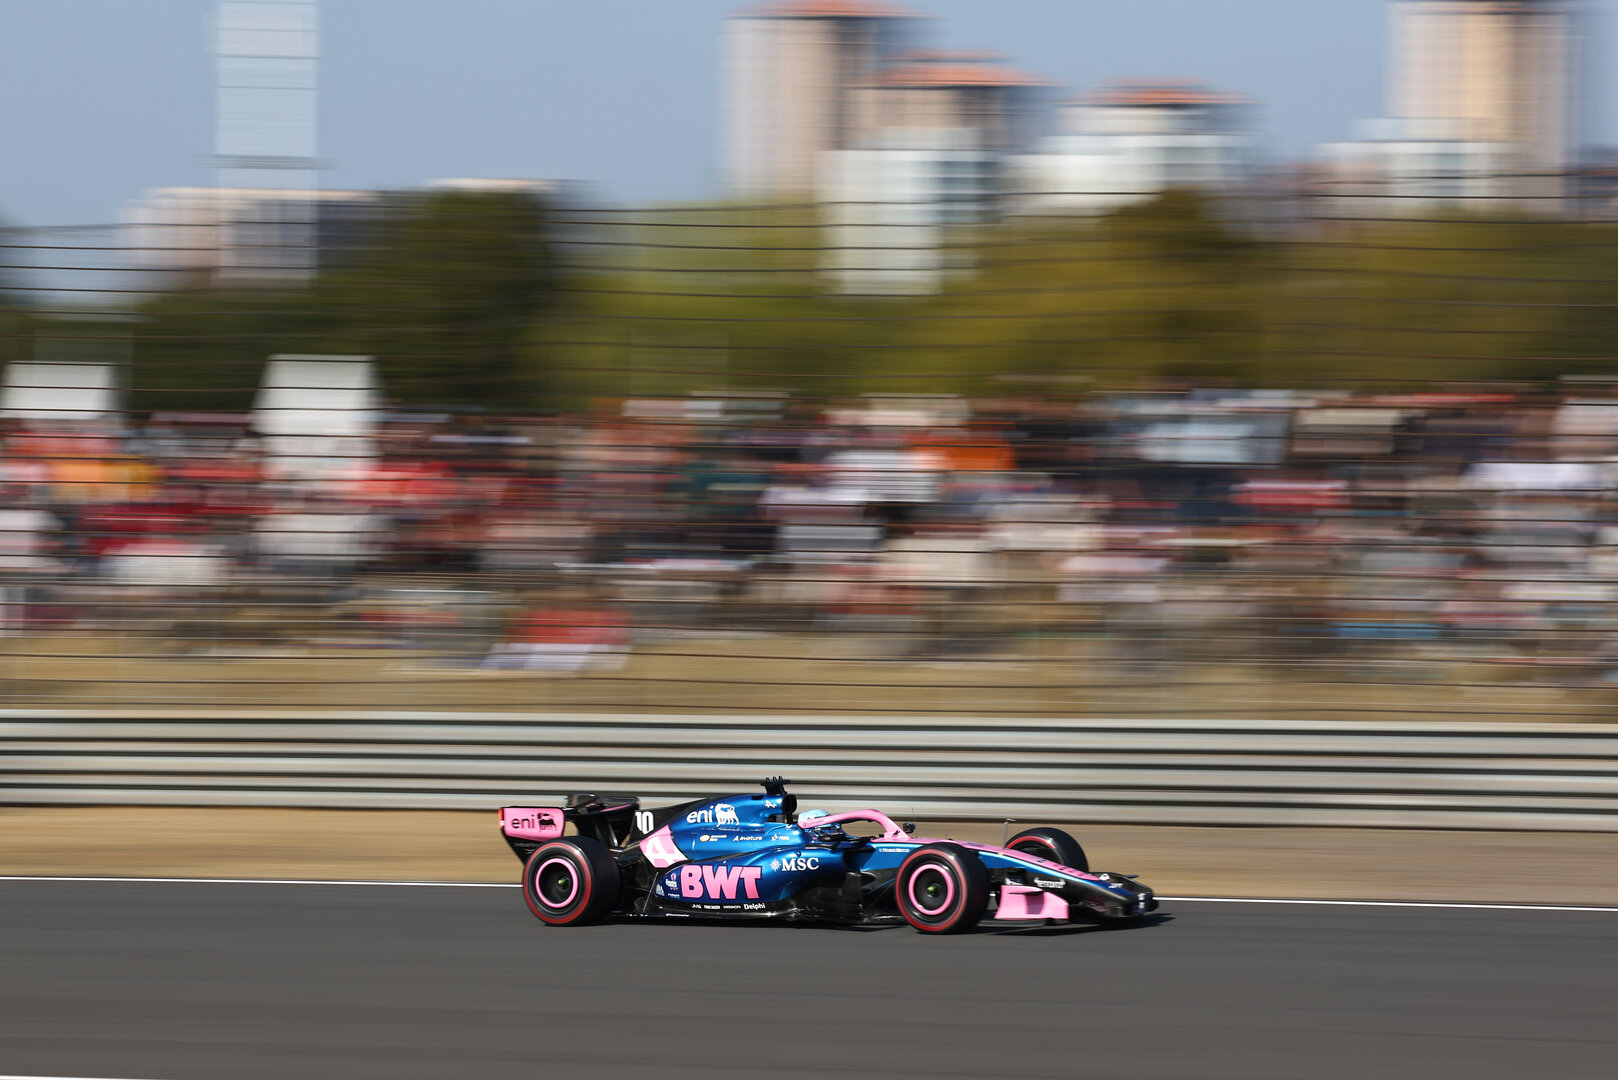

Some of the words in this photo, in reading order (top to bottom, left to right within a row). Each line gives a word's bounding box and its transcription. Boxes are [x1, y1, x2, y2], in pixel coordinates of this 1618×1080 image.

[511, 814, 535, 829] eni
[635, 811, 654, 835] 10
[686, 805, 714, 824] eni
[781, 857, 819, 872] MSC
[680, 865, 762, 899] BWT
[743, 903, 766, 911] Delphi
